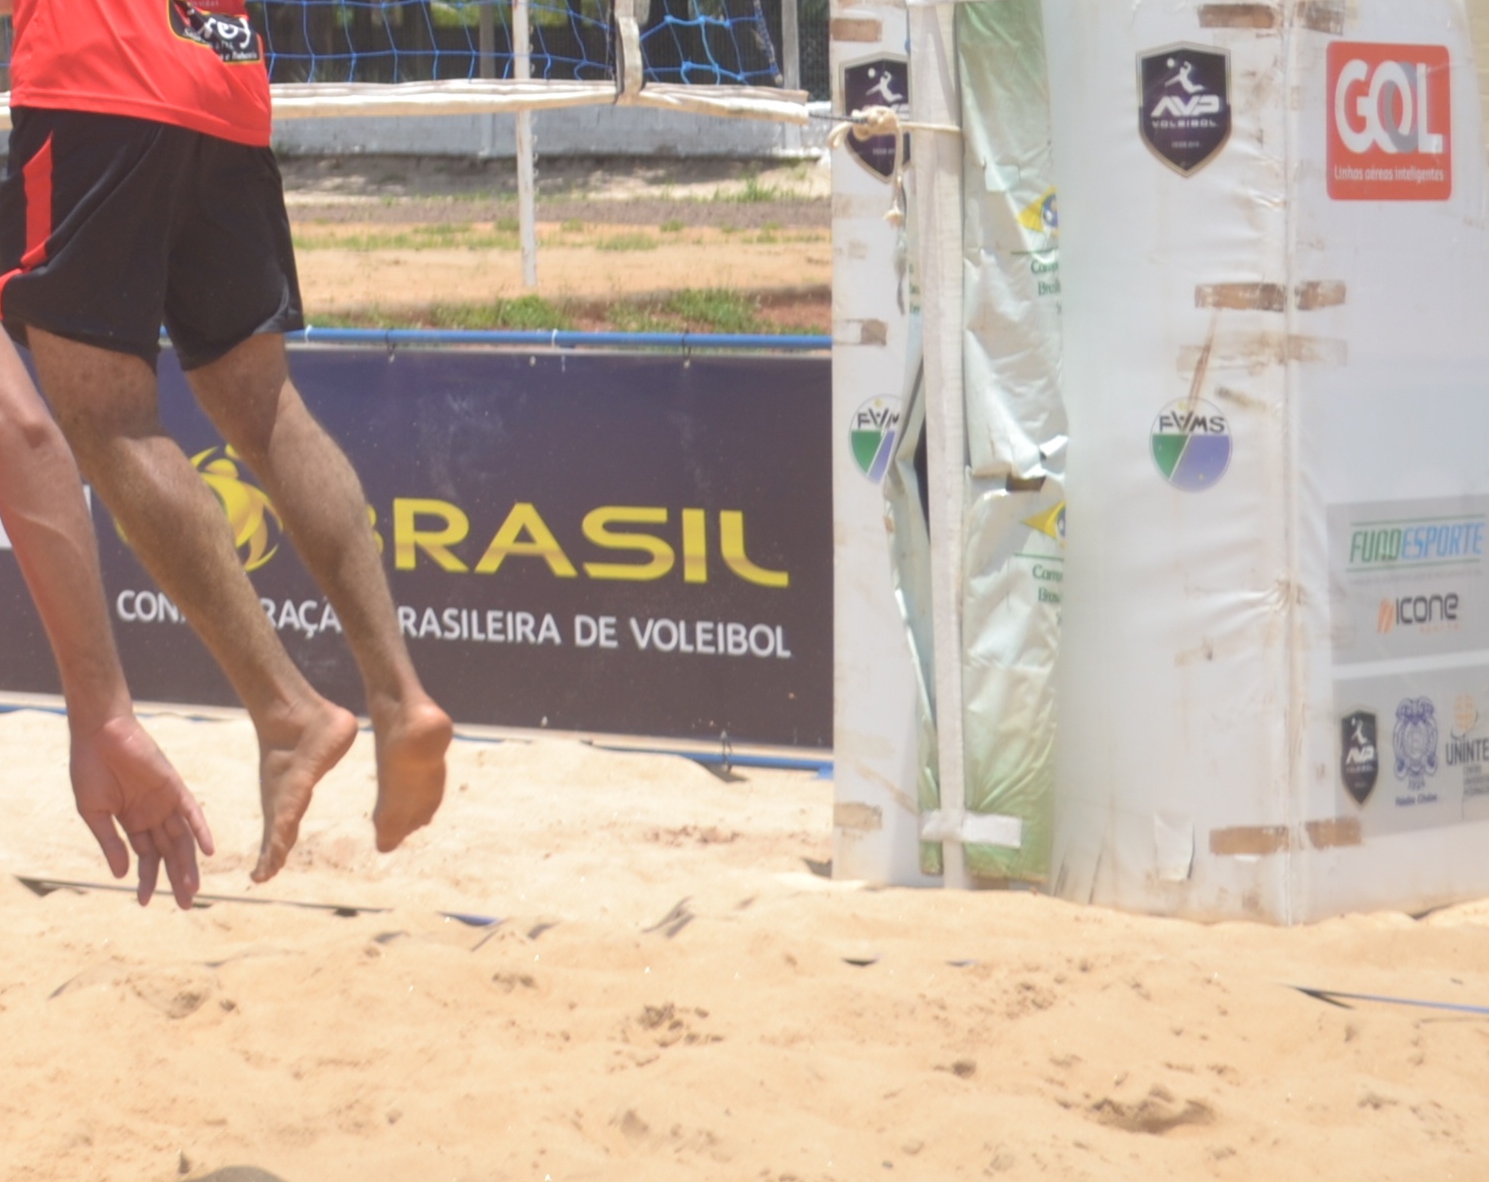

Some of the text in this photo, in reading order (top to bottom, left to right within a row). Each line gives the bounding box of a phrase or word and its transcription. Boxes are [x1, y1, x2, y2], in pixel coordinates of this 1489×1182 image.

[1334, 58, 1444, 154] GOL
[1159, 410, 1225, 433] FVMS
[366, 496, 789, 587] RASIL
[1349, 521, 1485, 563] FUNDESPORTE
[396, 605, 561, 646] RASILEIRA
[574, 614, 618, 648] DE
[630, 617, 792, 658] VOLEIBOL
